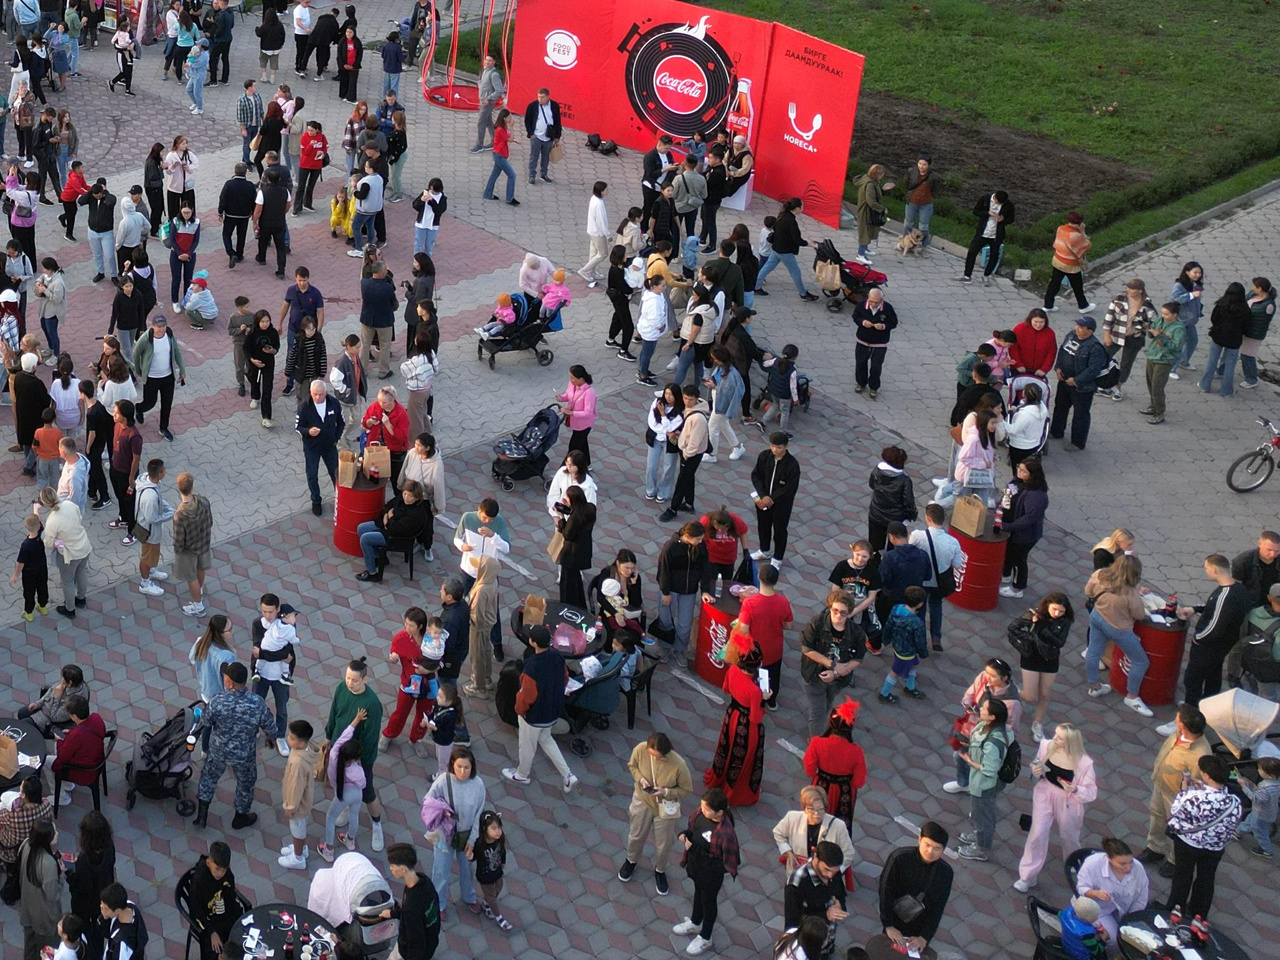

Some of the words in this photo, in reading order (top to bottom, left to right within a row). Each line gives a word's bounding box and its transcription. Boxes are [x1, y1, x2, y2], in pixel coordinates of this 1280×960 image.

[552, 48, 571, 56] FEST
[553, 42, 572, 51] FOOD
[803, 46, 828, 62] БИРГЕ
[785, 49, 844, 78] ДААМДУУРААК!
[656, 71, 705, 98] Coca-Cola
[707, 617, 728, 669] Coca-Cola
